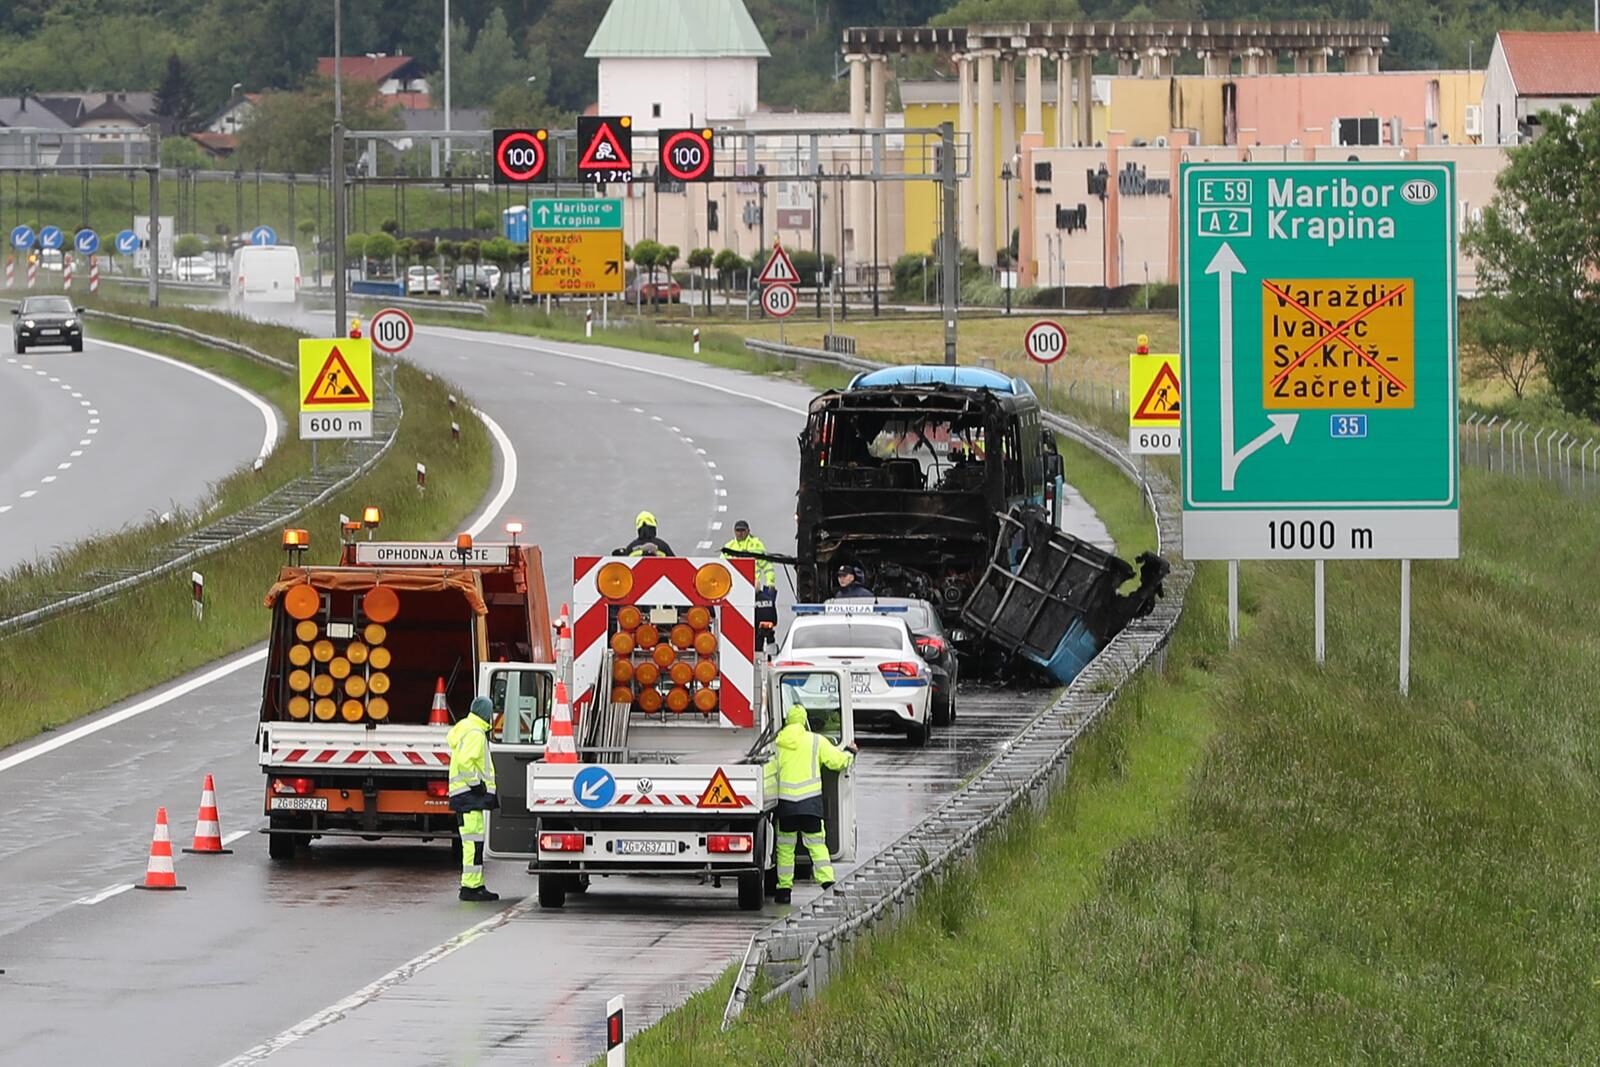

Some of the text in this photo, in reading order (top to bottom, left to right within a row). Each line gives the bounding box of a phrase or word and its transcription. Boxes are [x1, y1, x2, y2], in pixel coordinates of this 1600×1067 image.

[507, 148, 535, 165] 100
[673, 147, 700, 165] 100
[1203, 182, 1247, 201] E 59
[1267, 178, 1394, 208] Maribor
[1408, 184, 1431, 200] SLO
[553, 202, 600, 214] Maribor
[553, 214, 601, 227] Krapina
[1209, 213, 1239, 232] A 2
[1267, 210, 1395, 247] Krapina
[769, 291, 790, 309] 80
[1275, 284, 1403, 307] Varaždin
[378, 320, 406, 341] 100
[1273, 314, 1368, 337] Ivanec
[1032, 332, 1060, 352] 100
[1273, 374, 1400, 403] Začretje
[310, 417, 362, 432] 600 m
[1338, 417, 1359, 435] 35
[1139, 434, 1171, 448] 600
[1268, 520, 1373, 550] 1000 m
[377, 548, 444, 561] OPHODNJA
[827, 605, 872, 613] POLICIJA
